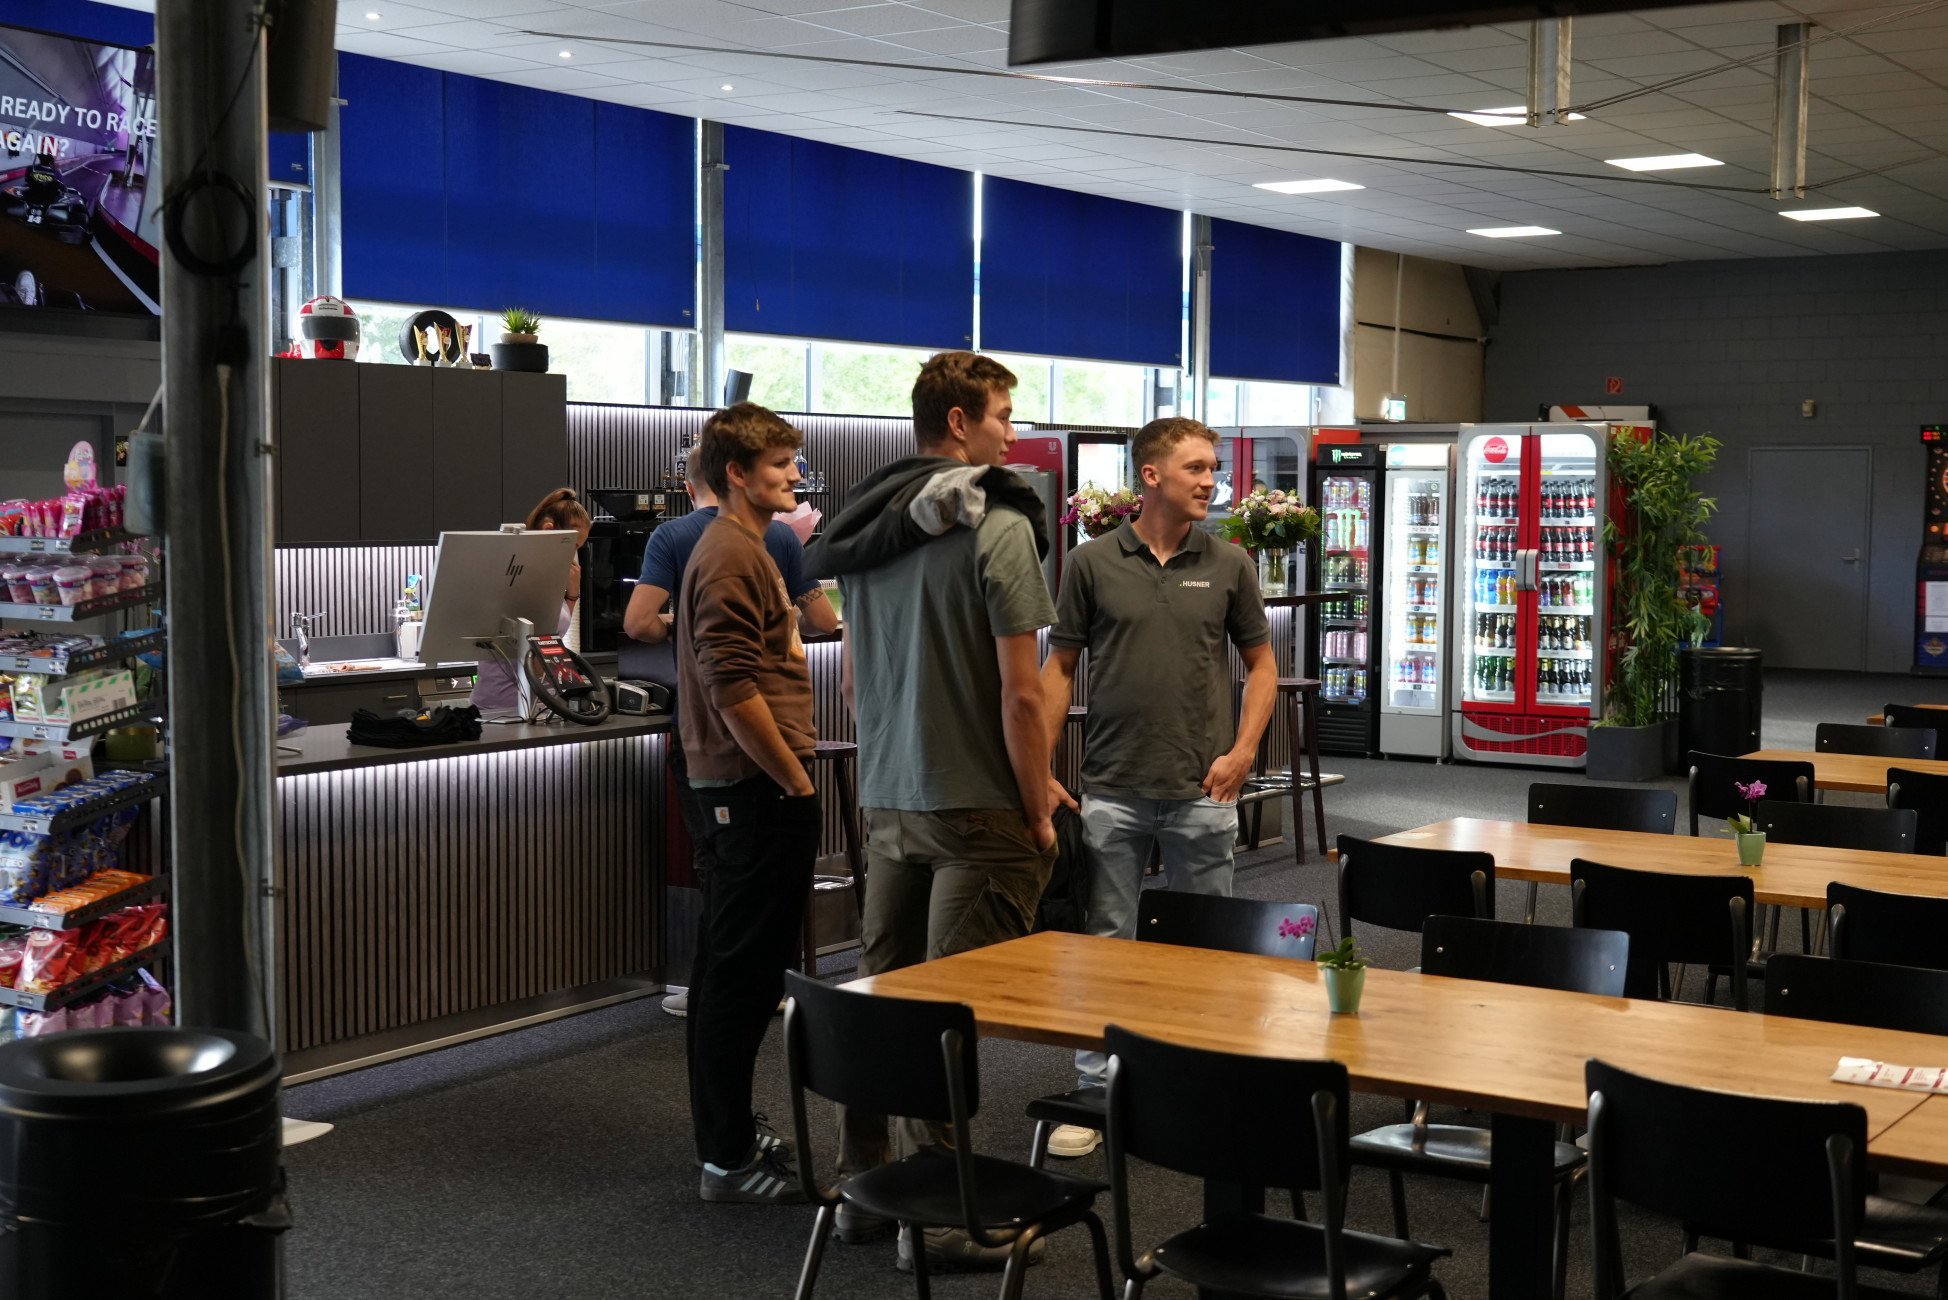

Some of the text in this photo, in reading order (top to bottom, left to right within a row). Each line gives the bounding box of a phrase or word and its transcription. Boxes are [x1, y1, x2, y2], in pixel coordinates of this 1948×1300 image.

[1, 95, 157, 138] READY TO RACE
[0, 128, 70, 157] AGAIN?
[505, 553, 524, 587] hp
